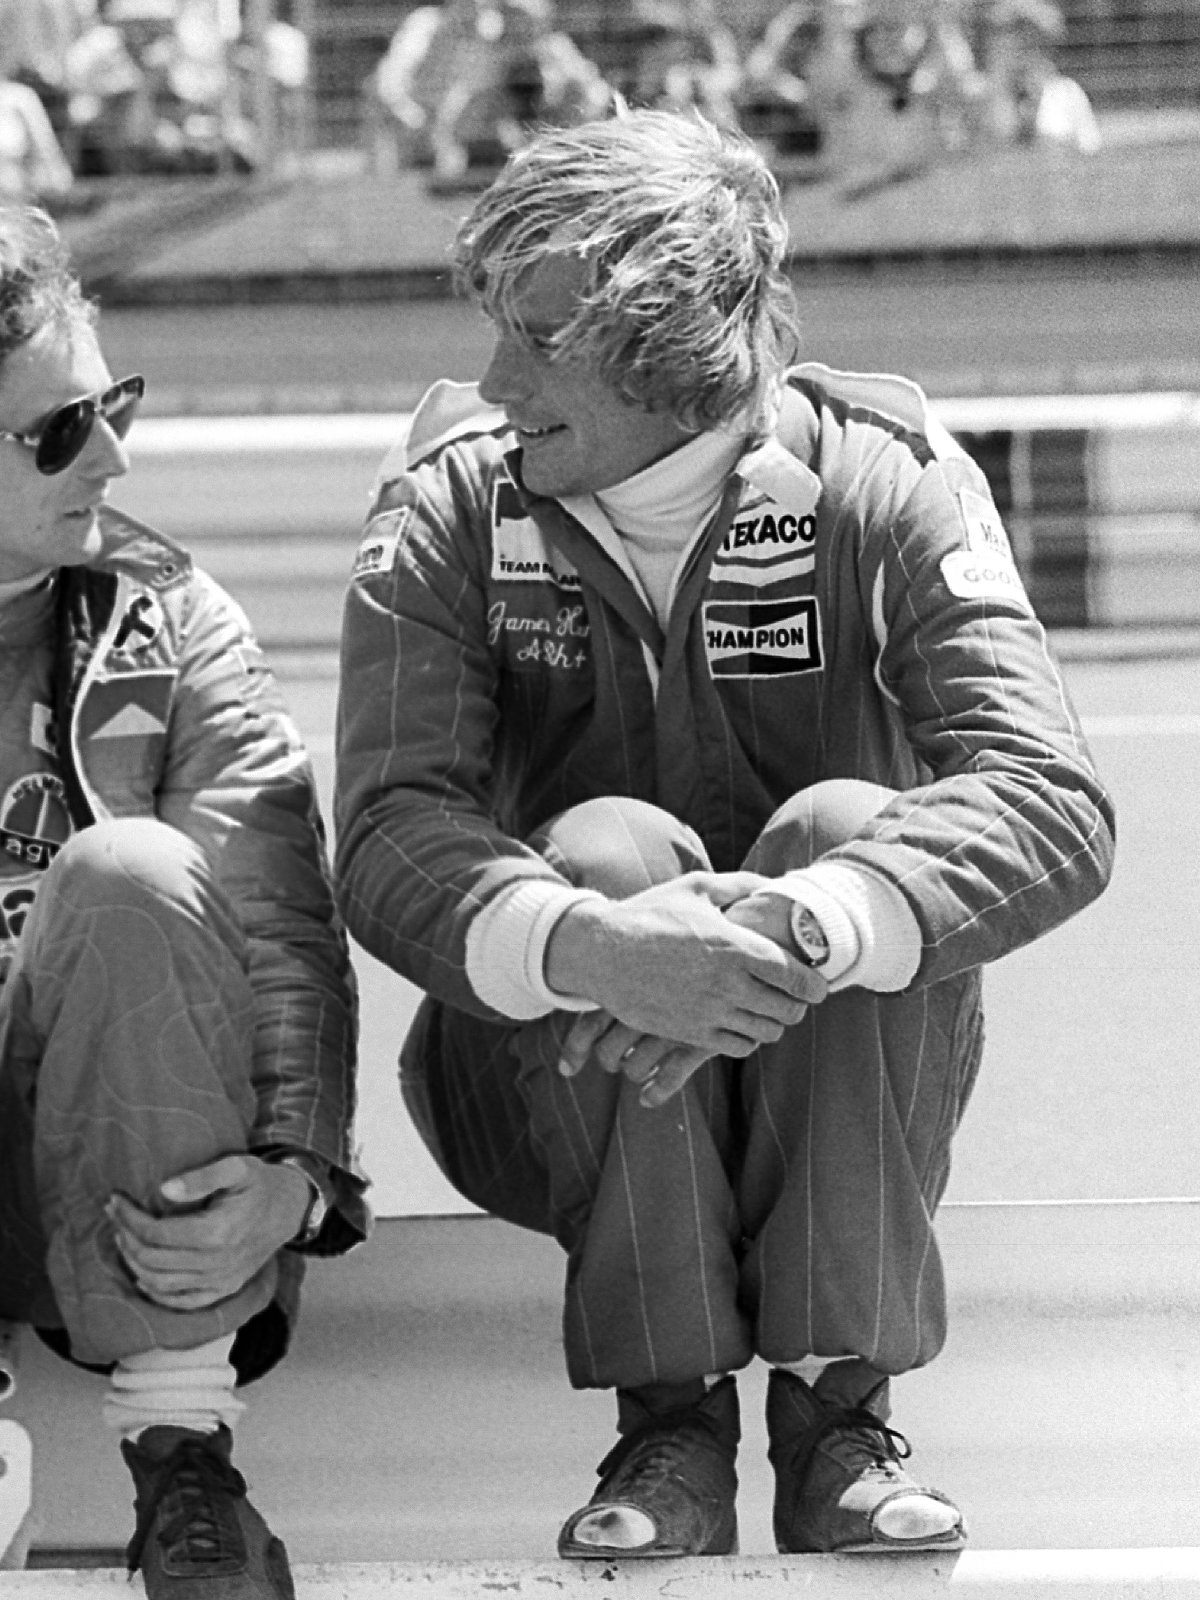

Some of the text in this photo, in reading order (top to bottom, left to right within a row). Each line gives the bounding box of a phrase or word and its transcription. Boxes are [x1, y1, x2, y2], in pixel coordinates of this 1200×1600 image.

[723, 514, 816, 551] TEXACO
[500, 560, 540, 573] TEAM
[706, 626, 805, 649] HAMPION
